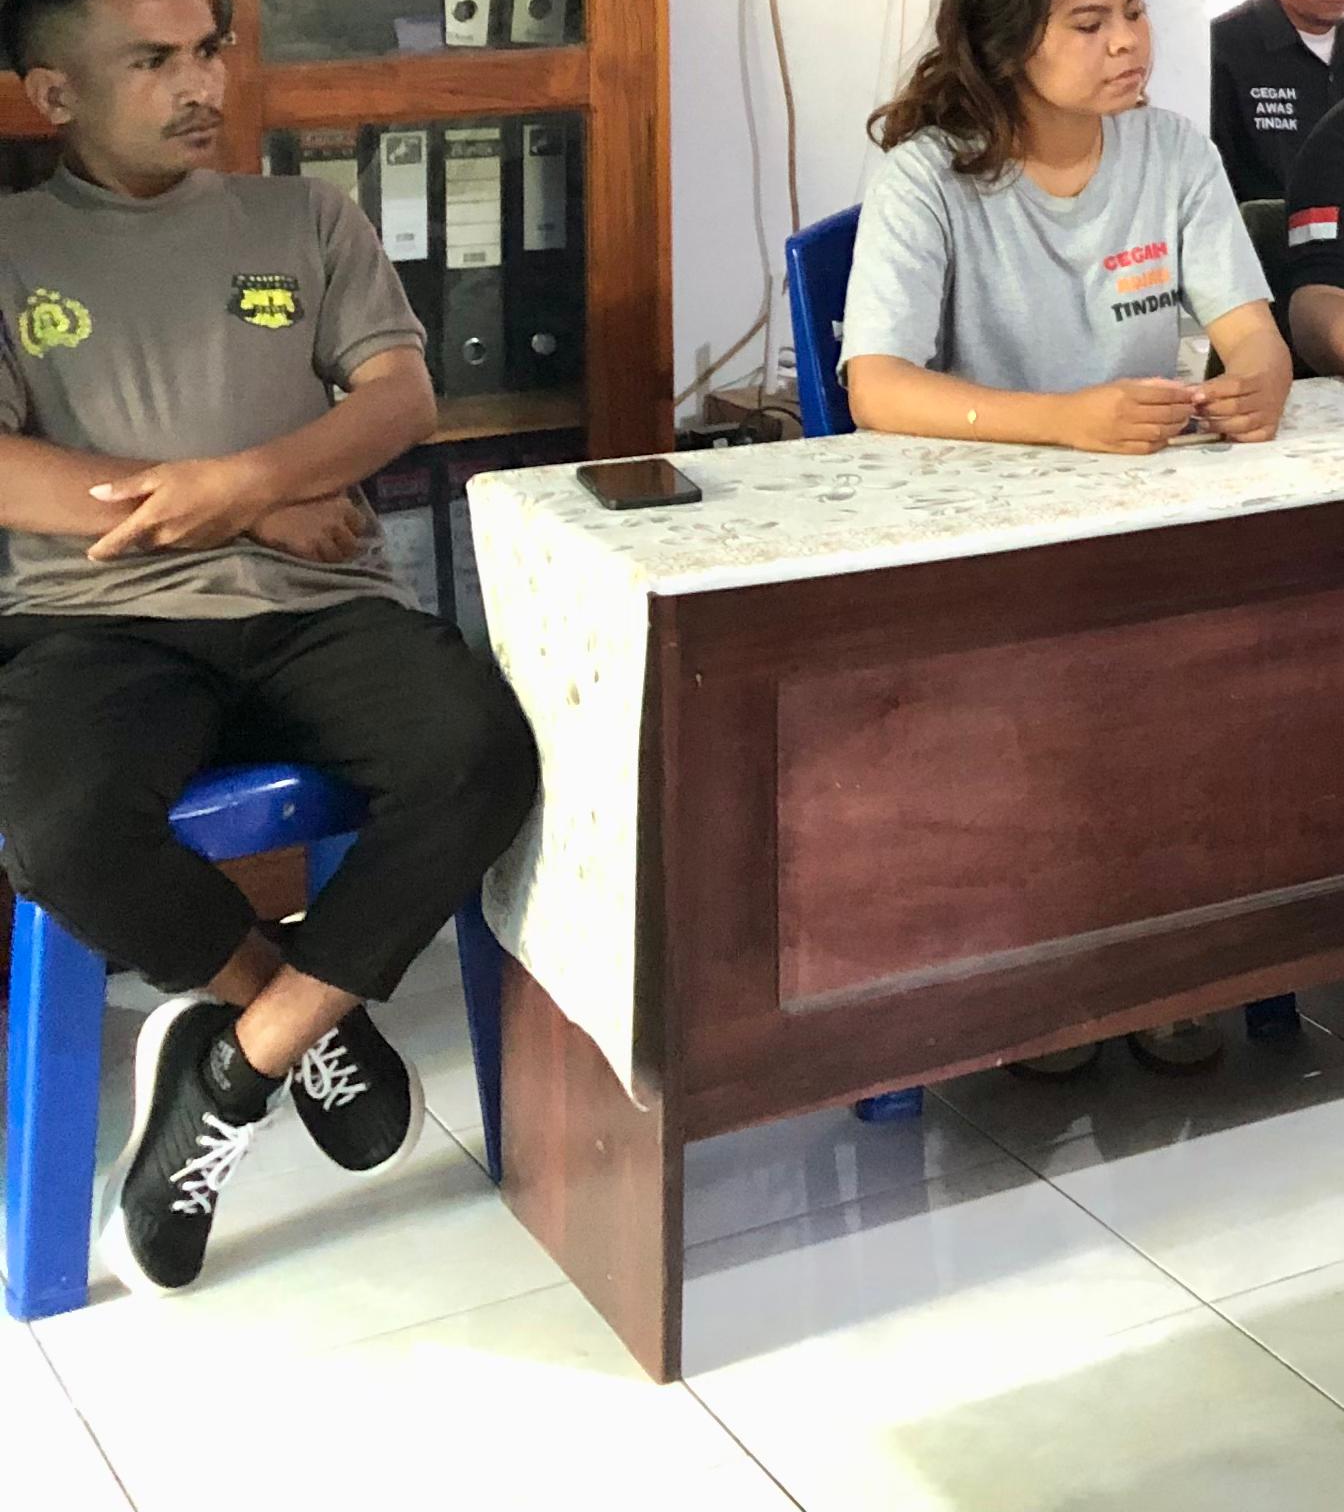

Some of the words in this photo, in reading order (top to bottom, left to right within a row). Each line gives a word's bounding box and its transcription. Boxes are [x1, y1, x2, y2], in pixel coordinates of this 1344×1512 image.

[1250, 87, 1297, 100] CEGAH
[1256, 102, 1294, 114] AWAS
[1254, 117, 1298, 130] TINDAK
[1103, 241, 1168, 271] CEGAH
